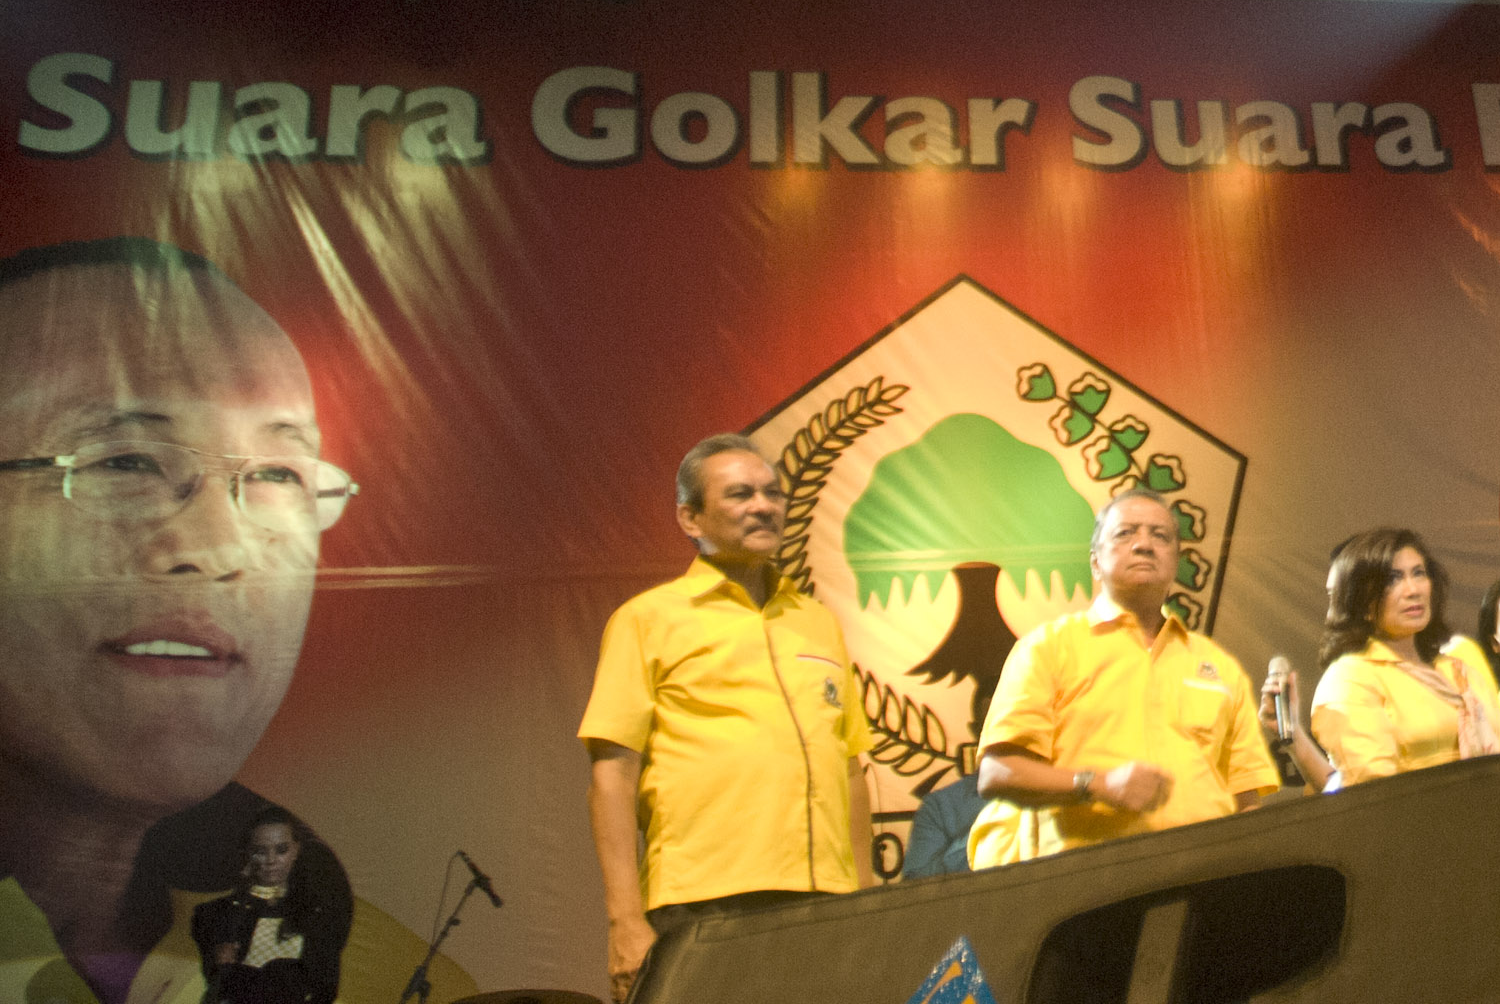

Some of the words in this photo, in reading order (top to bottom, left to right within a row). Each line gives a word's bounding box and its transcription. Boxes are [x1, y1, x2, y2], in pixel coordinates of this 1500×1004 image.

[17, 52, 490, 163] Suara
[530, 66, 1036, 170] Golkar
[1067, 75, 1449, 171] Suara
